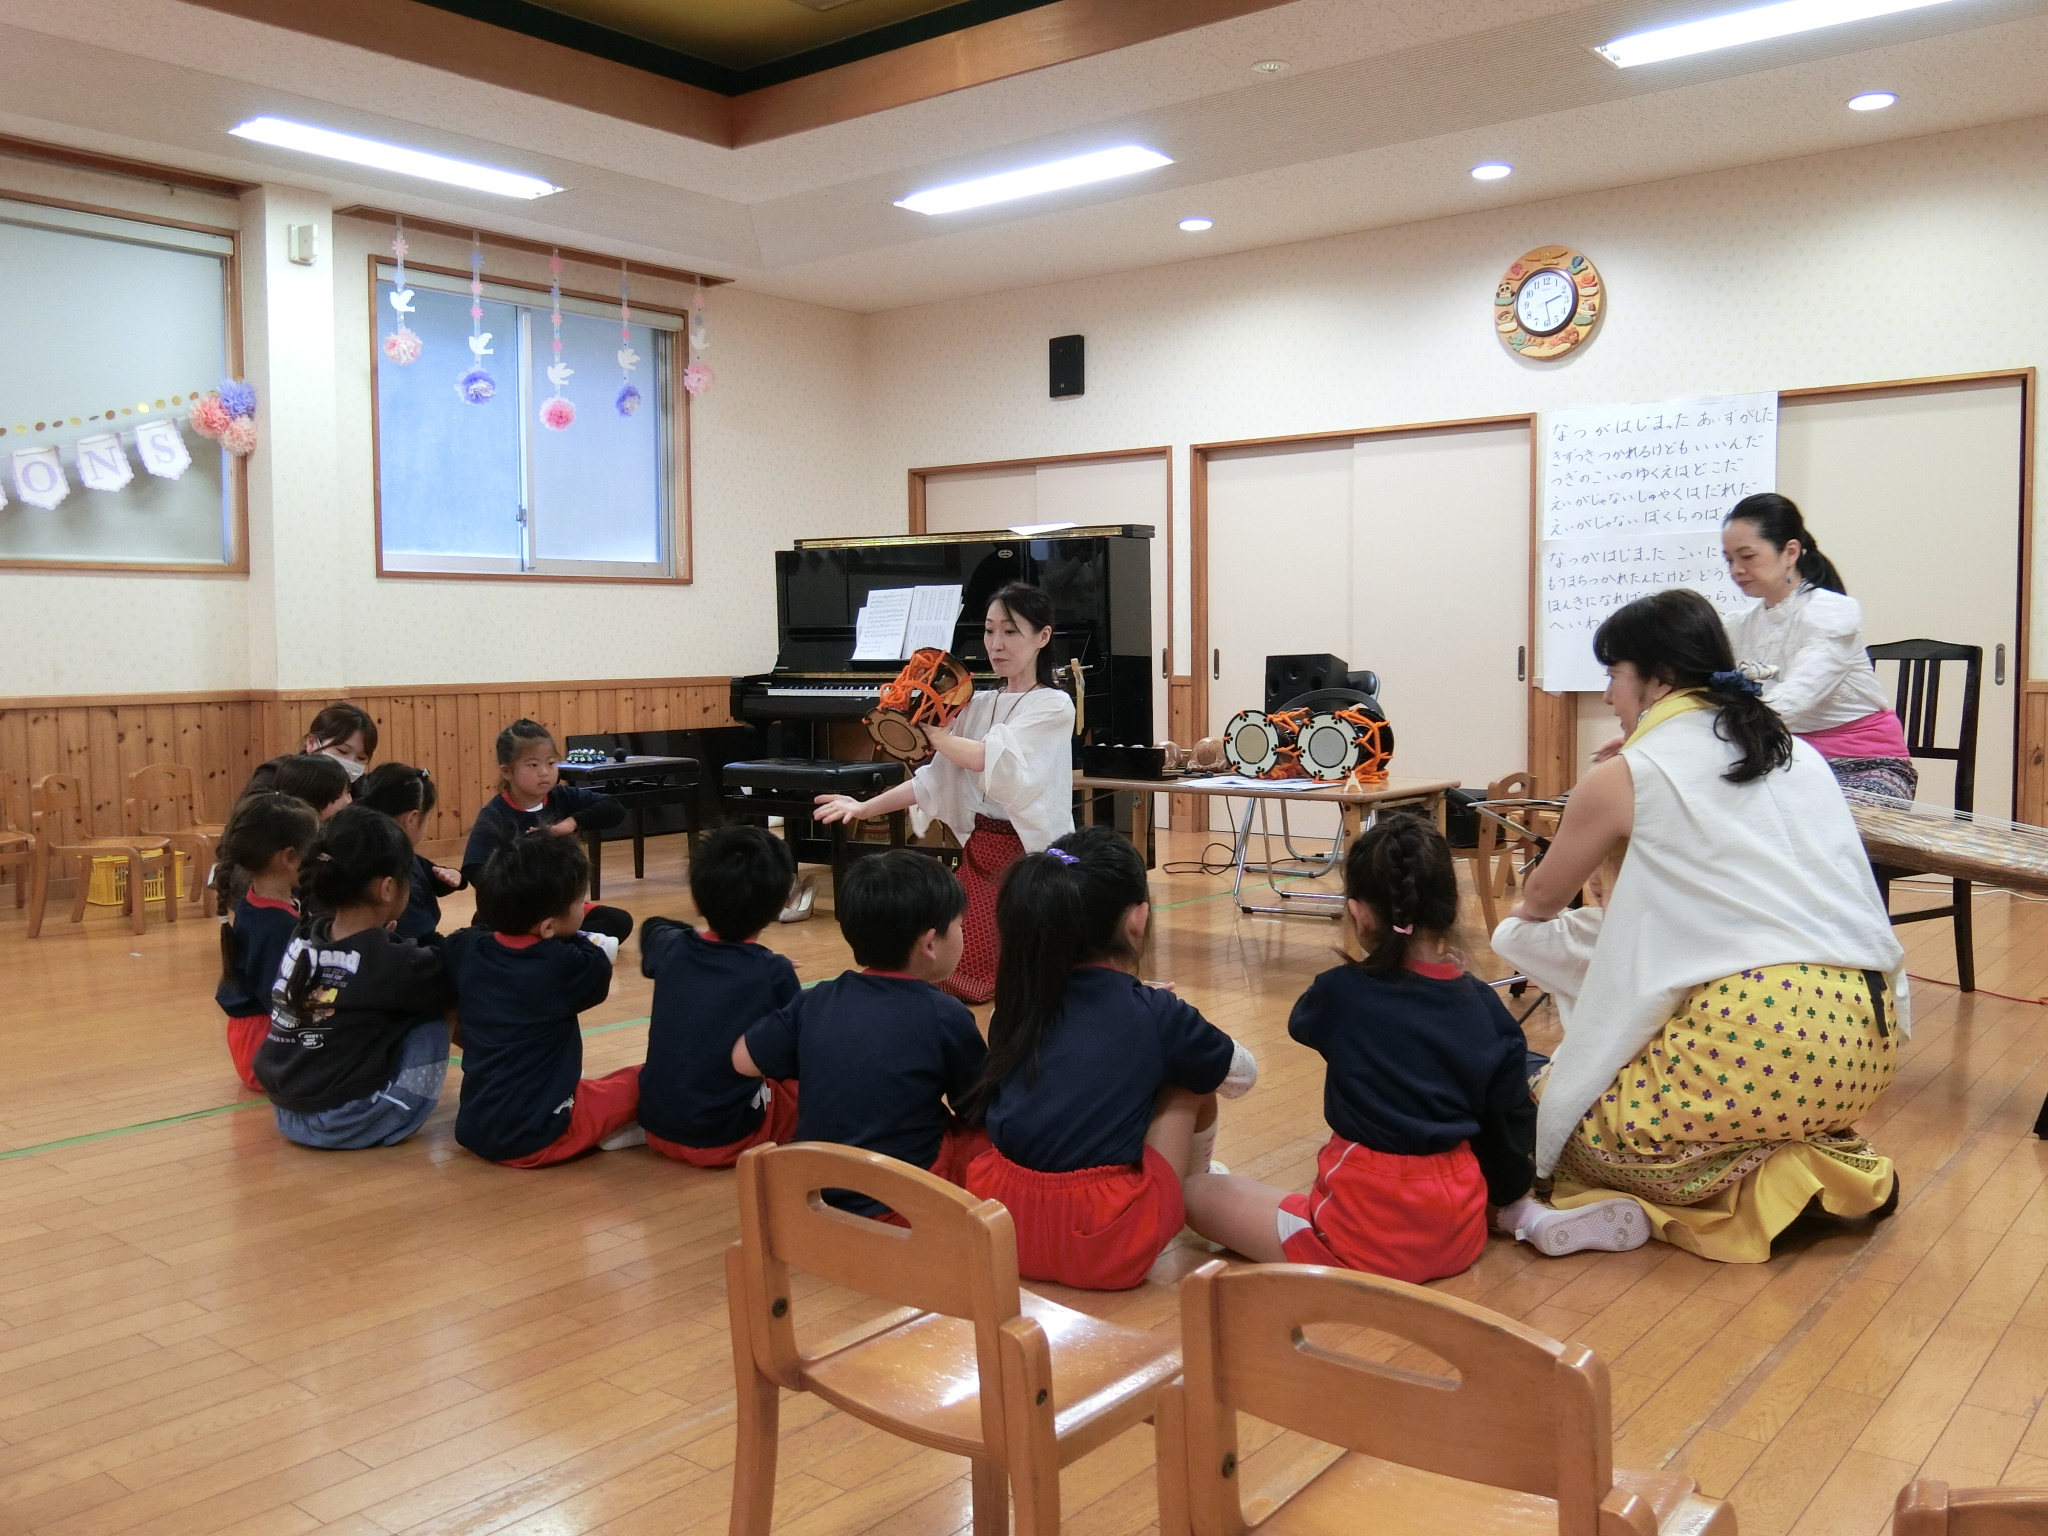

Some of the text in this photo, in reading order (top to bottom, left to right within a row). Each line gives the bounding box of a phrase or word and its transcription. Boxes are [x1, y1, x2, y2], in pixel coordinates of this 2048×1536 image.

[1543, 277, 1550, 285] 12
[1555, 278, 1558, 286] 1
[1534, 282, 1540, 290] 11
[1562, 285, 1567, 294] 2
[1526, 290, 1534, 298] 10
[1564, 296, 1569, 304] 3
[1561, 306, 1566, 314] 4
[1534, 318, 1539, 326] 7
[1554, 316, 1559, 324] 5
[319, 950, 361, 974] and
